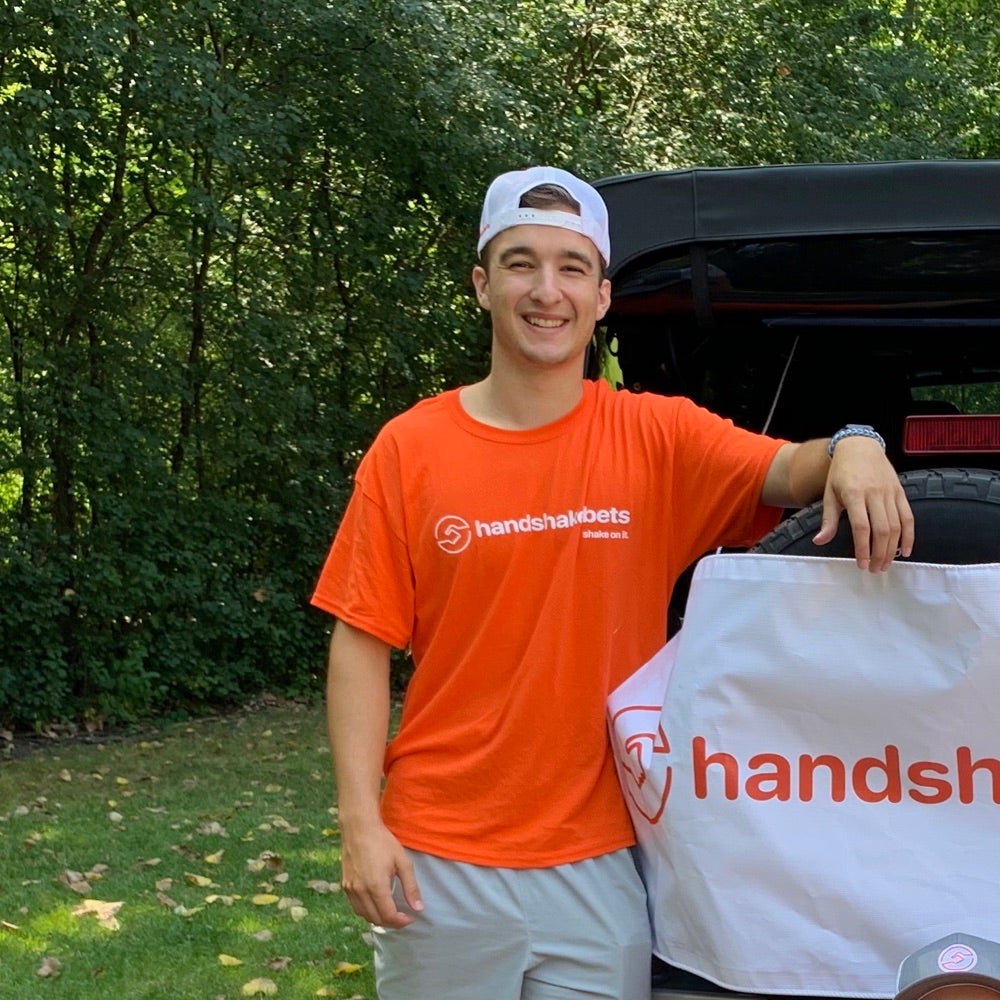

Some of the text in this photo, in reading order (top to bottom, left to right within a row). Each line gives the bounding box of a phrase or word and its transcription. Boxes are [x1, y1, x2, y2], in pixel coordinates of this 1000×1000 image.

[582, 506, 631, 524] bets
[582, 530, 609, 538] shake
[610, 531, 621, 539] on
